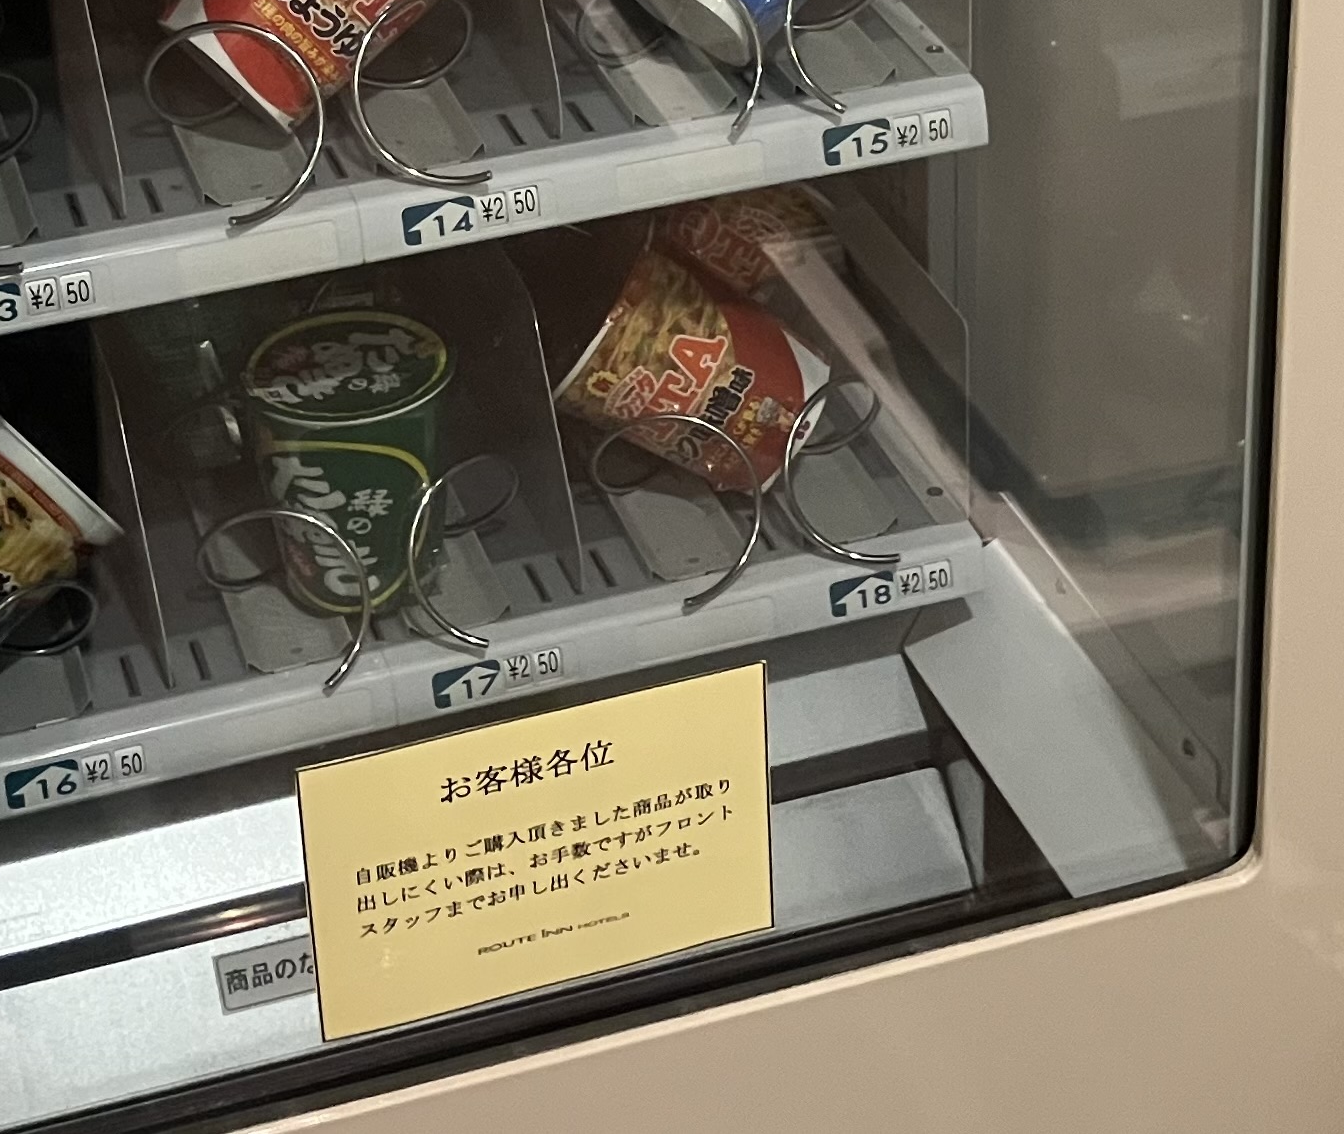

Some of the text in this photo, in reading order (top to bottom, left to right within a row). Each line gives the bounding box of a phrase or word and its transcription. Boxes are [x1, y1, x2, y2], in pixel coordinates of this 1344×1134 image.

[852, 131, 888, 157] 15
[433, 213, 473, 237] 14
[857, 584, 892, 609] 18
[462, 672, 499, 699] 17
[440, 739, 614, 804] お客様各位
[36, 774, 78, 800] 16
[355, 777, 732, 887] 自販機よりご購入頂きました商品が取り
[356, 804, 735, 915] 出しにくい際は、お手数ですがフロント
[359, 841, 703, 938] スタッフまでお申し出くださいませ。
[476, 933, 536, 956] ROUTE
